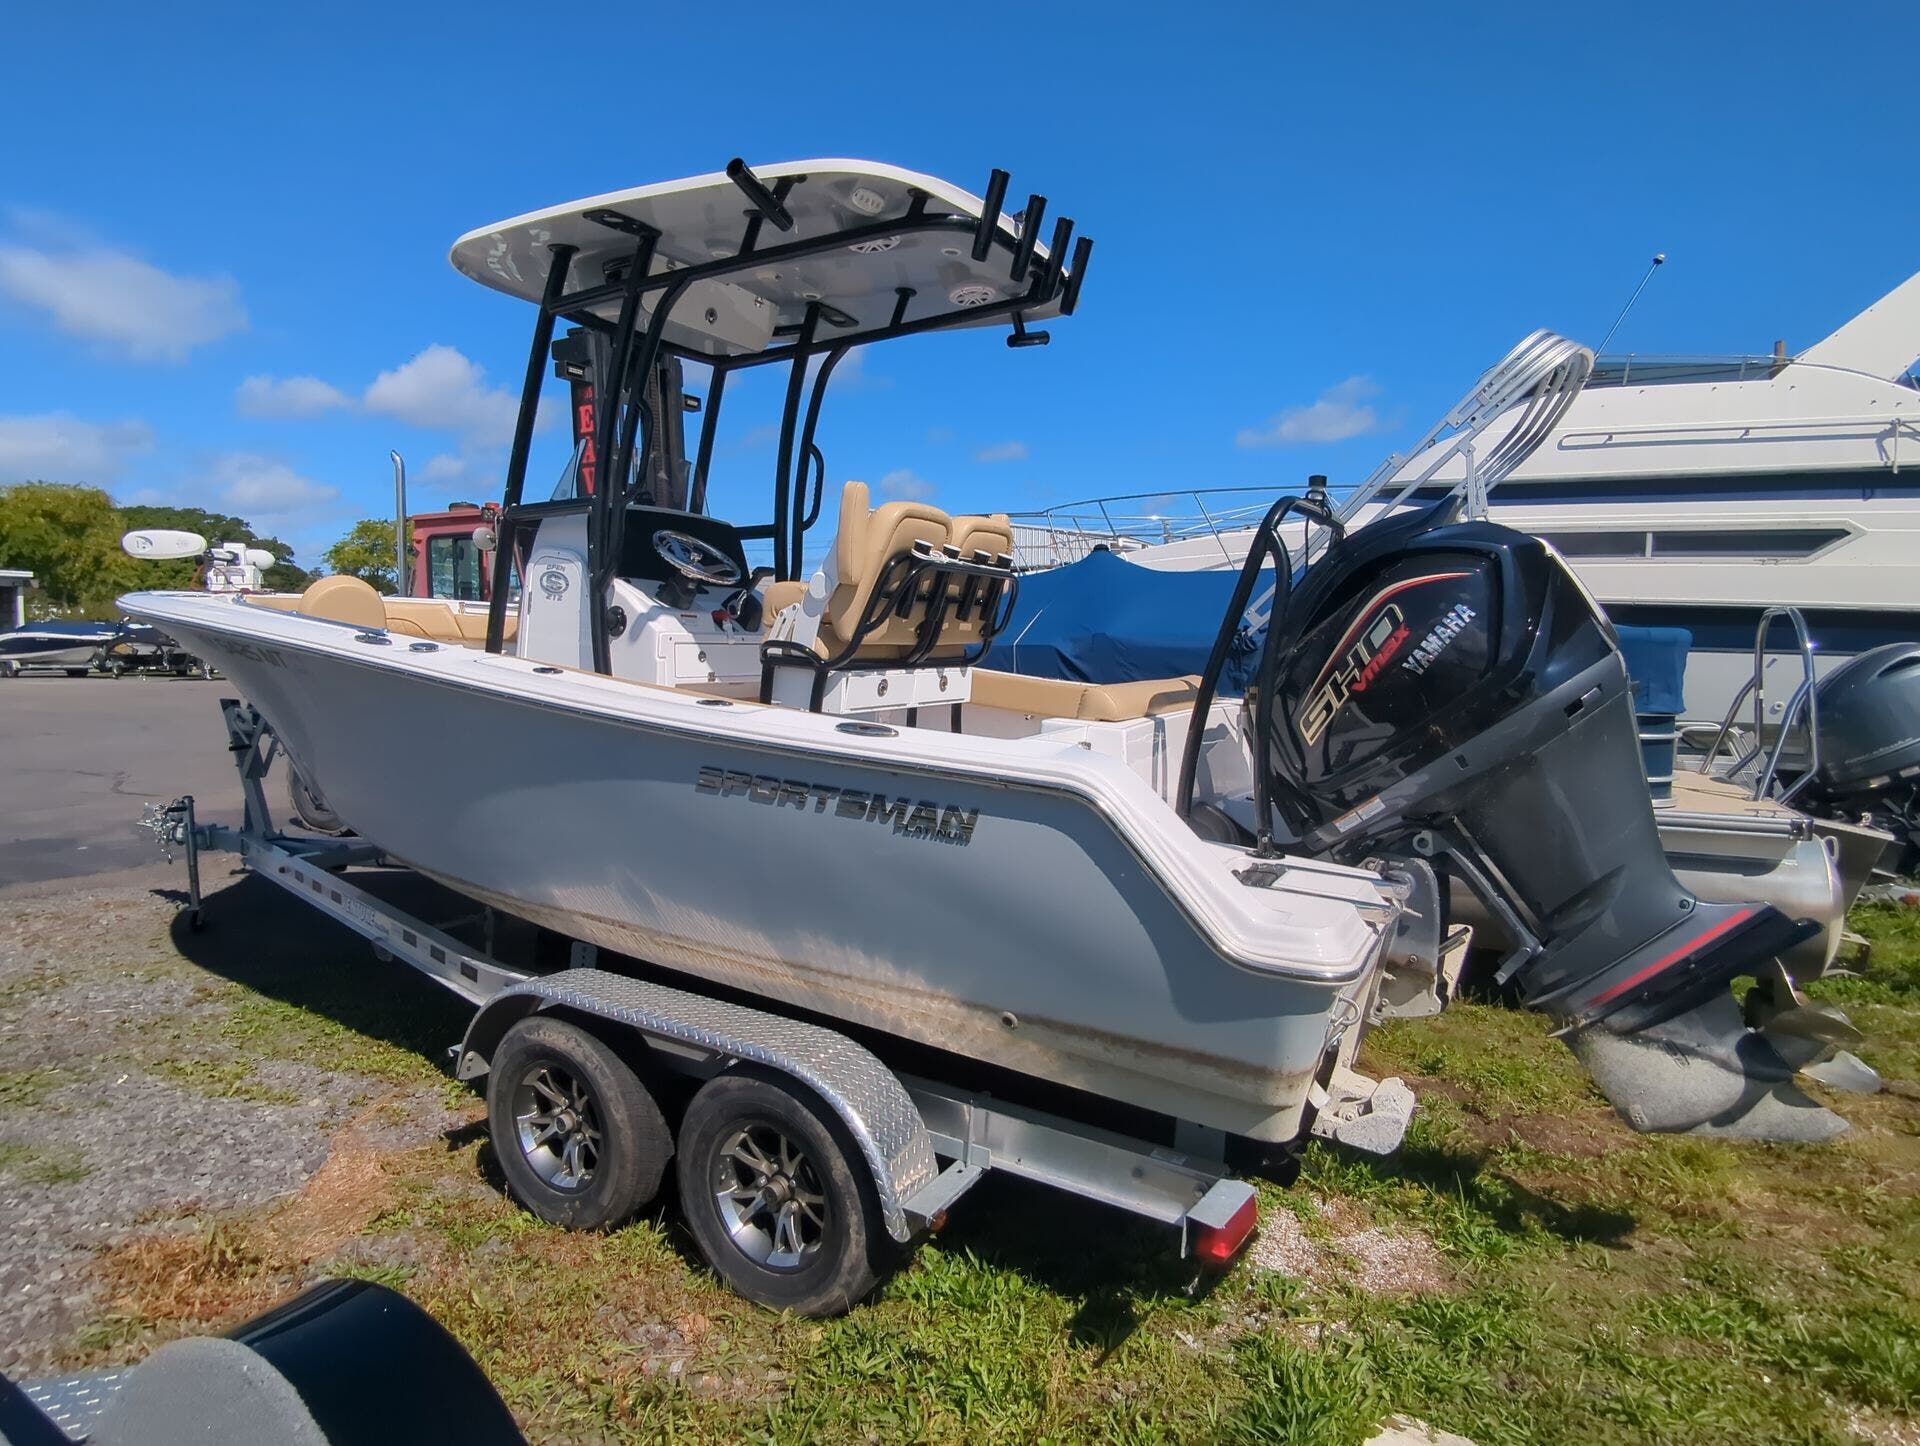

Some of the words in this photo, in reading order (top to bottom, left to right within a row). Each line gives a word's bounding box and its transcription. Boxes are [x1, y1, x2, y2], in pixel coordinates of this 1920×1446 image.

[1300, 603, 1404, 746] SHO
[1401, 603, 1477, 676] YAMAHA
[695, 766, 979, 834] SPORTSMAN
[892, 822, 973, 847] PLATINUM
